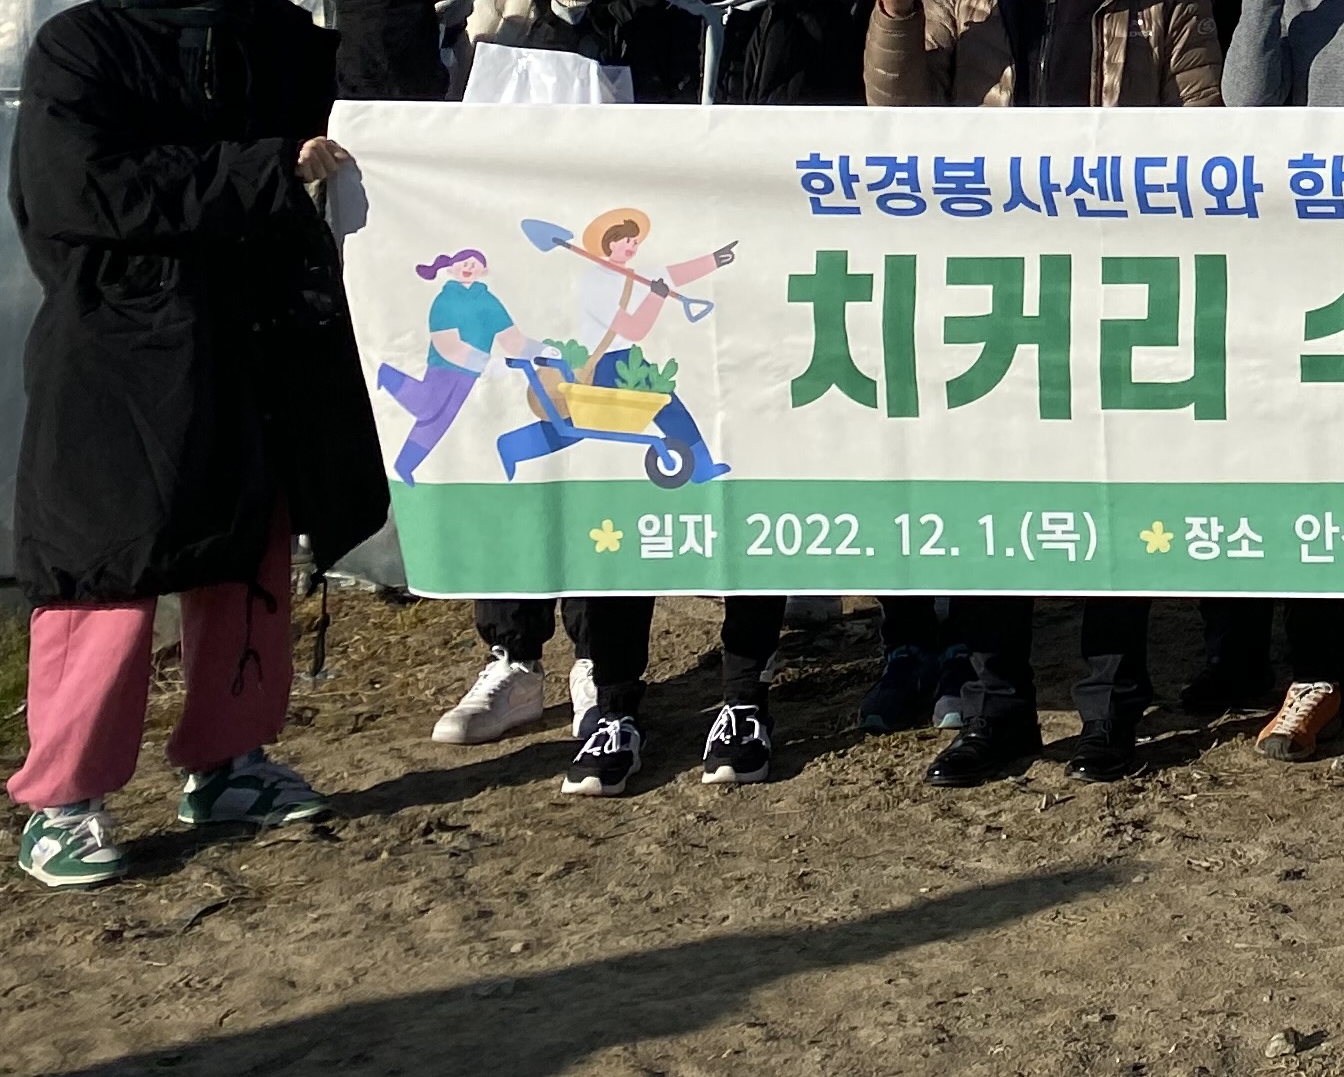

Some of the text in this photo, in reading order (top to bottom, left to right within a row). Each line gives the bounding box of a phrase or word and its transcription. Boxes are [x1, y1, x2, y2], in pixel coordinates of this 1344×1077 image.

[795, 152, 1264, 220] 한경봉사센터와
[788, 251, 1226, 420] 치커리
[637, 513, 718, 559] 일자
[746, 513, 875, 556] 2022.
[894, 513, 960, 556] 12.
[1184, 516, 1265, 560] 장소
